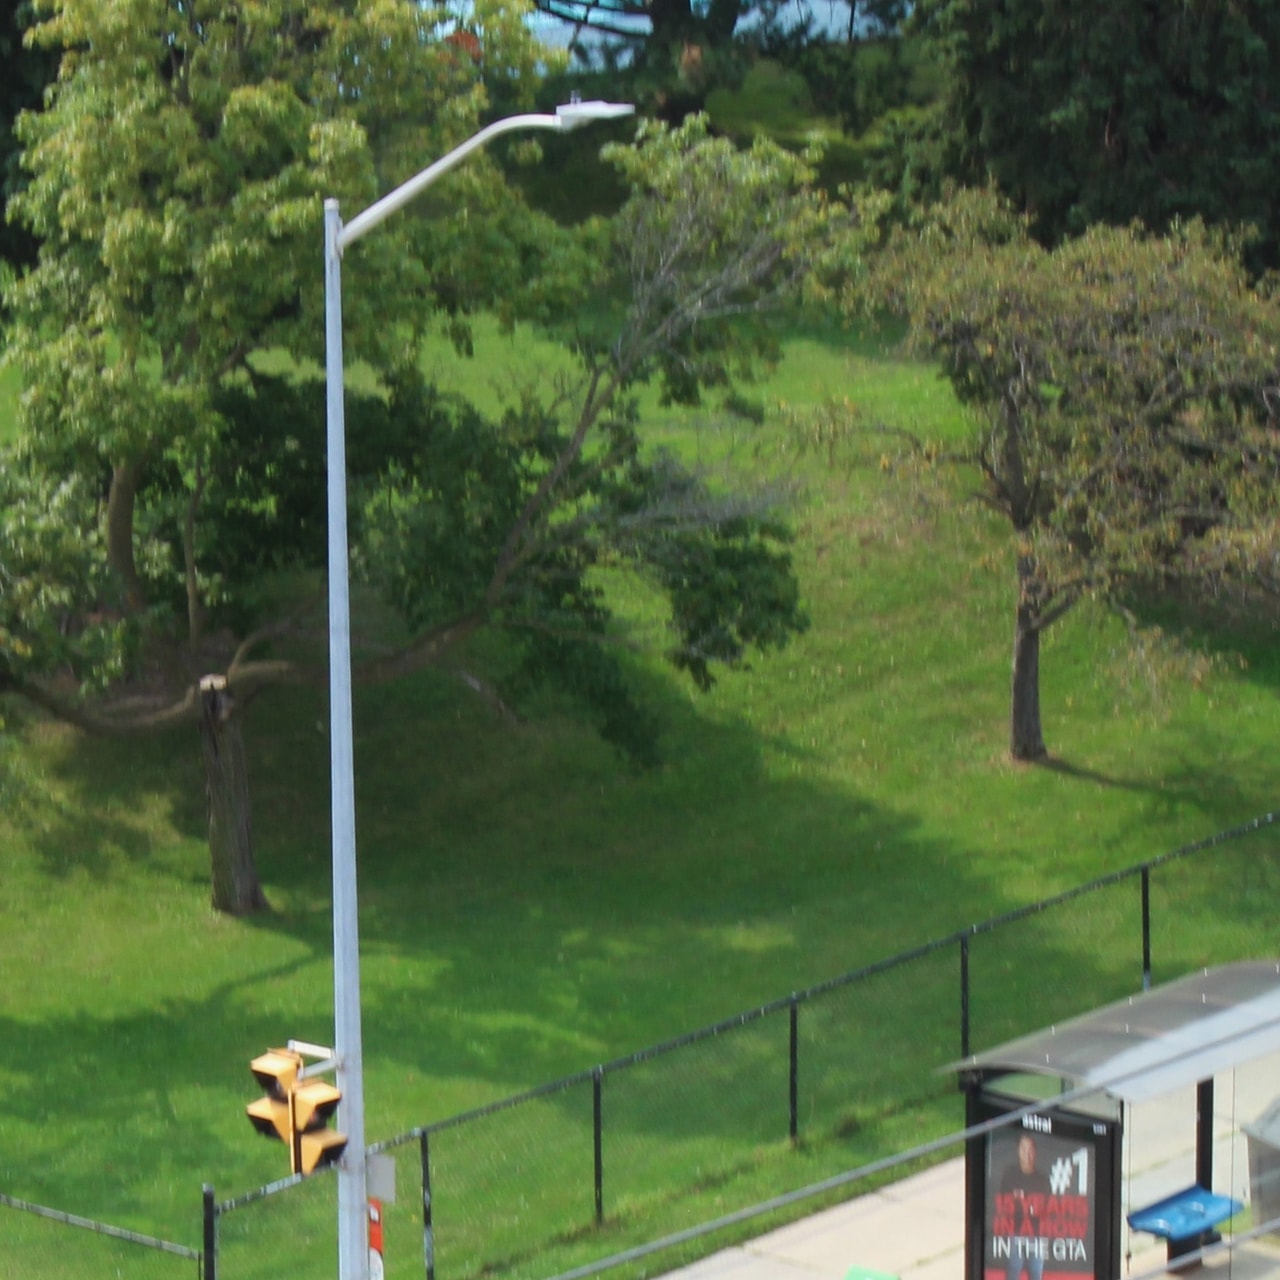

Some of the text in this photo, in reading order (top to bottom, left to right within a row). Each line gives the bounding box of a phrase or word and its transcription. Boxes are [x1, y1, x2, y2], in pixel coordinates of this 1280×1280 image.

[1049, 1147, 1088, 1196] #1
[992, 1235, 1088, 1262] IN THE GTA
